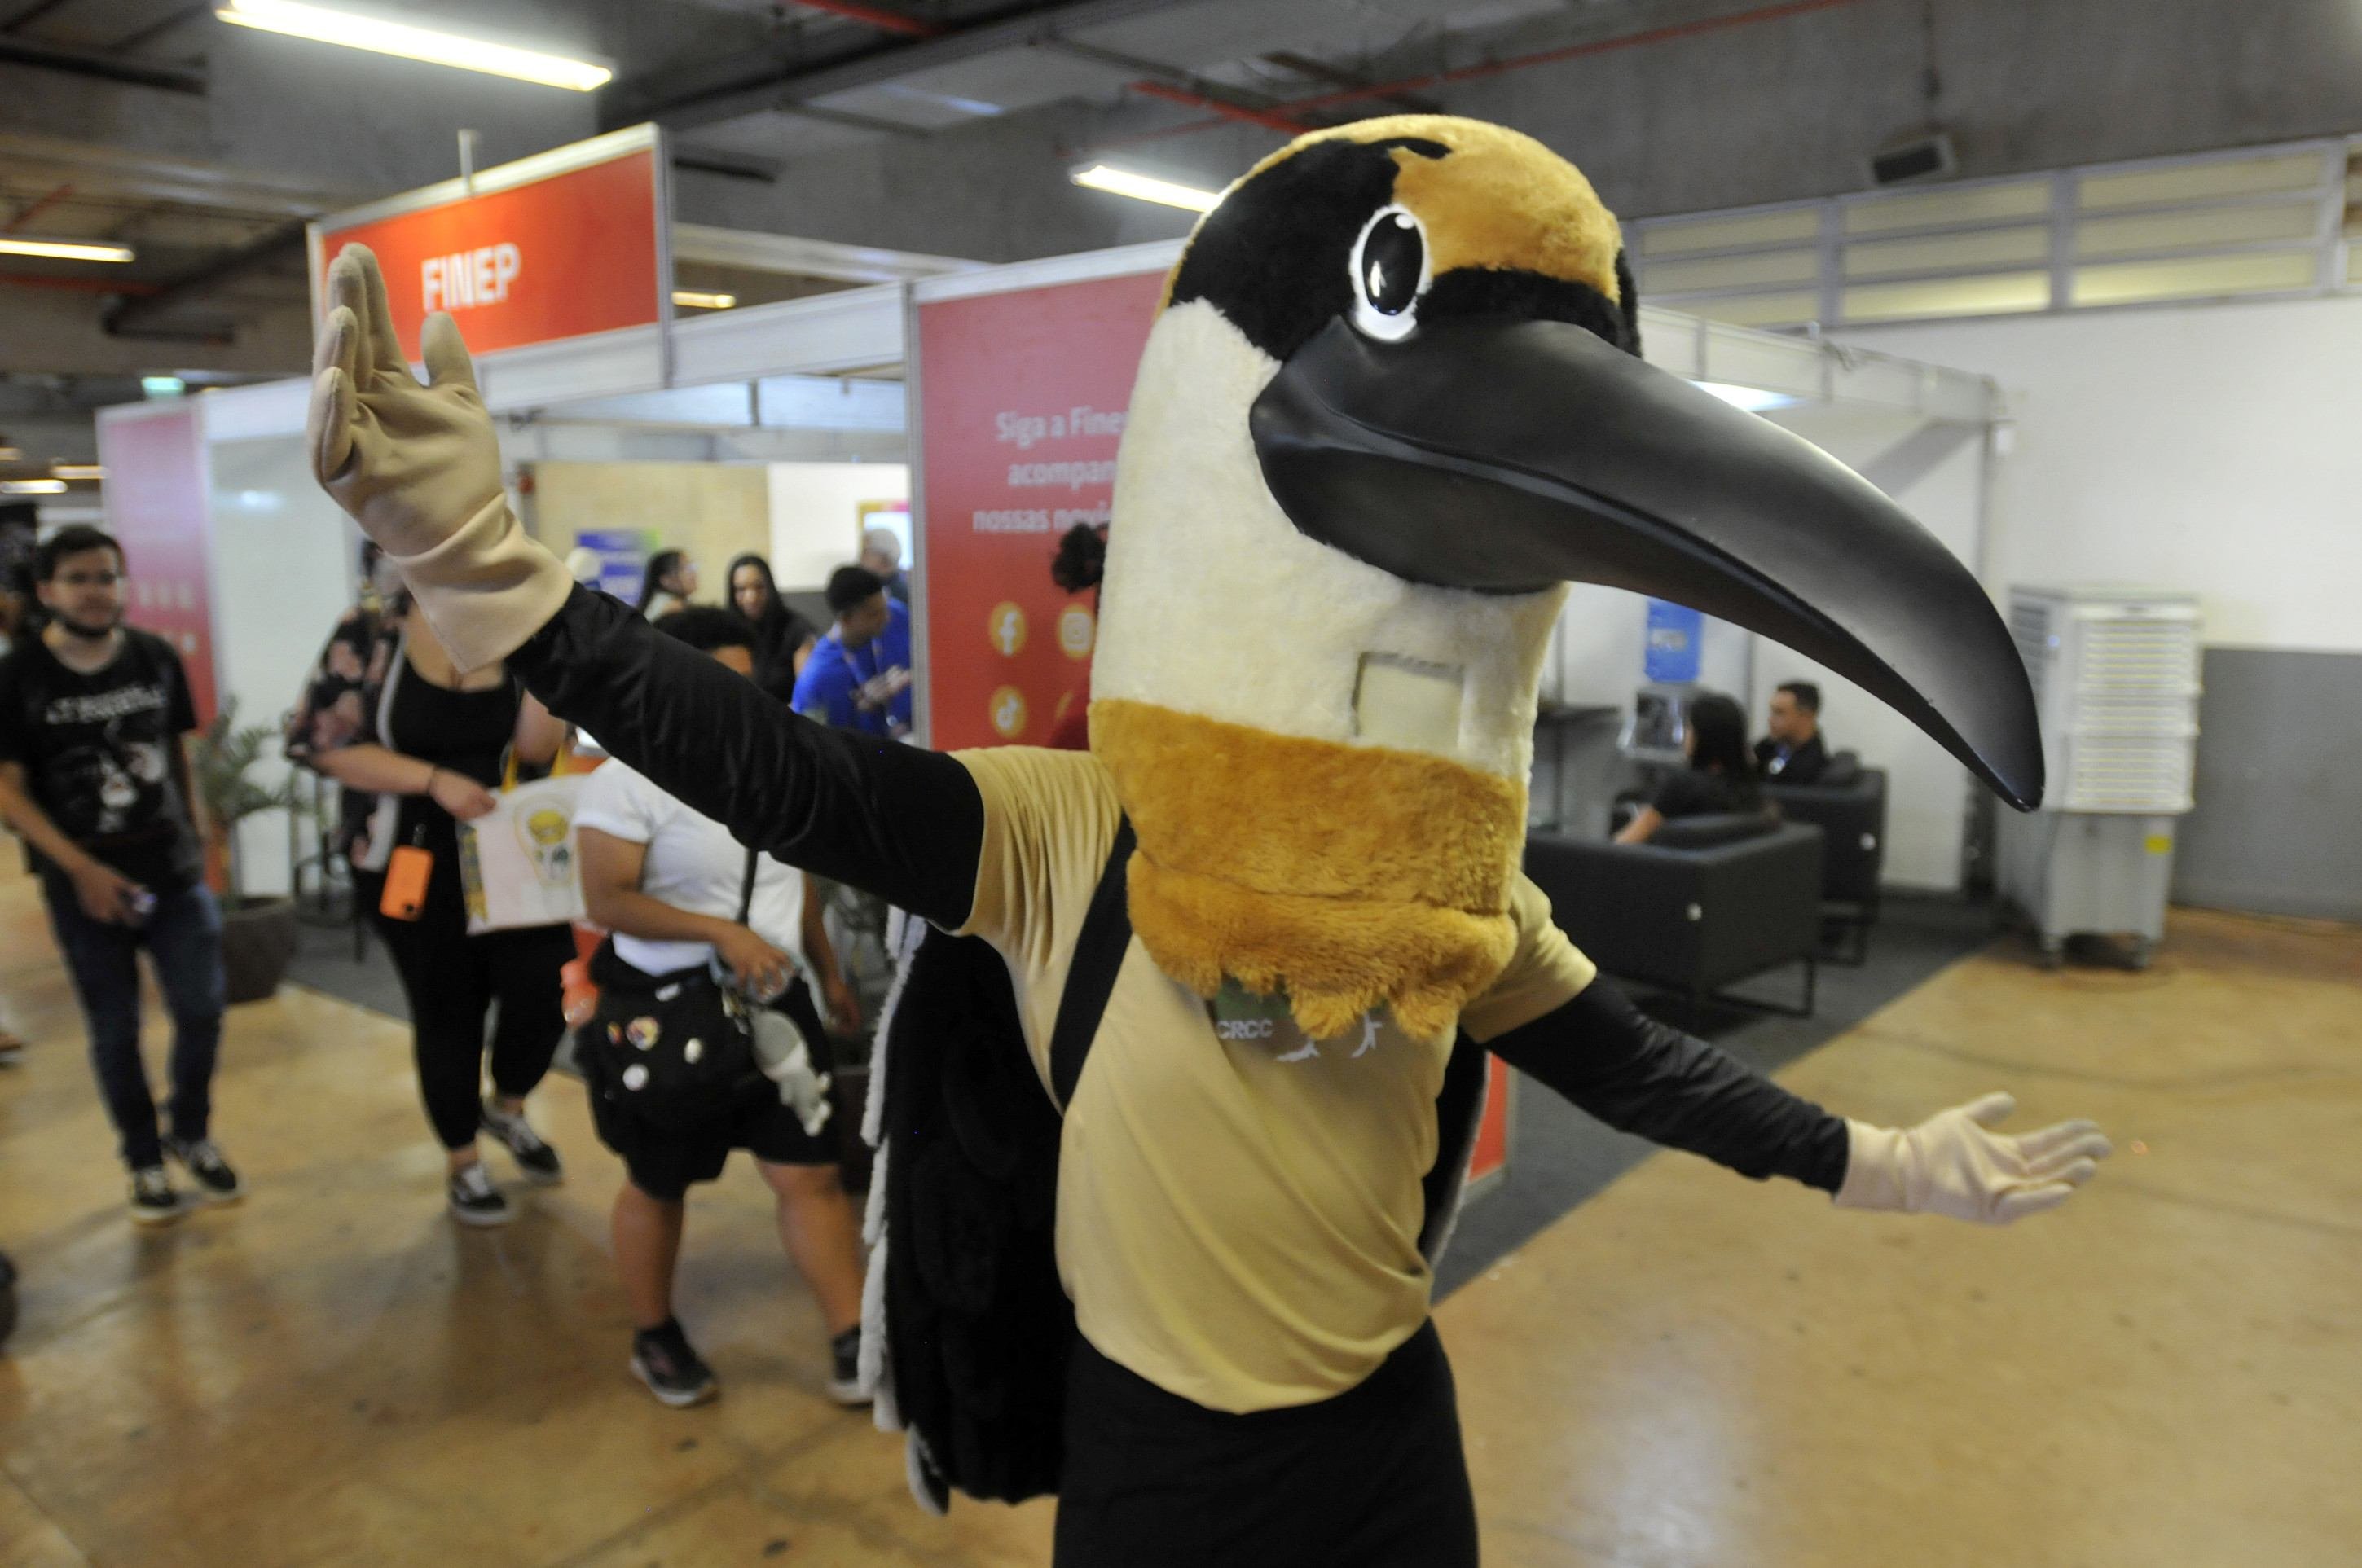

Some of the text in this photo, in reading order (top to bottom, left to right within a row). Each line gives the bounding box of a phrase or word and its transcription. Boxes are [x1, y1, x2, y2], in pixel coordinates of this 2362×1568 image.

[422, 243, 521, 312] FINEP
[996, 411, 1046, 449] Siga
[1051, 415, 1066, 438] a
[973, 509, 1049, 534] nossas
